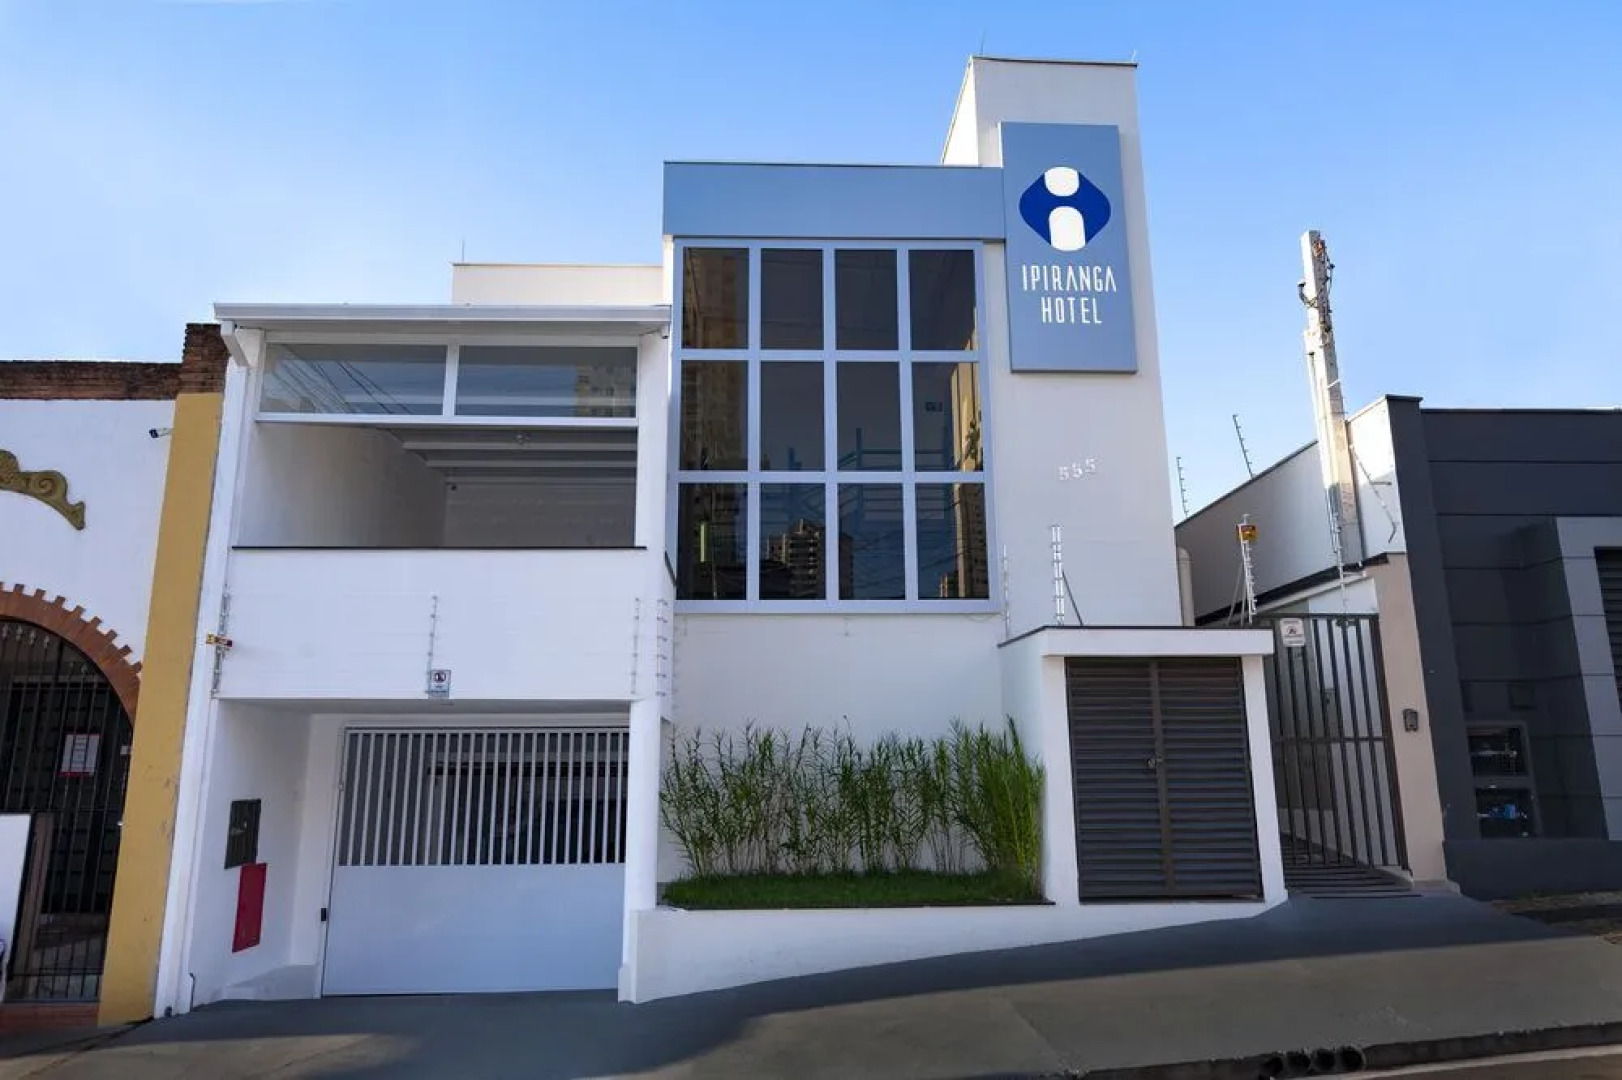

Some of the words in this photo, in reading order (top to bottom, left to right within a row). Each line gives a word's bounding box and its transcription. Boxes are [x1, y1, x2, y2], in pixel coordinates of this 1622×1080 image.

[1022, 265, 1117, 292] IPIRANGA
[1041, 297, 1103, 324] HOTEL
[1058, 458, 1096, 481] 555
